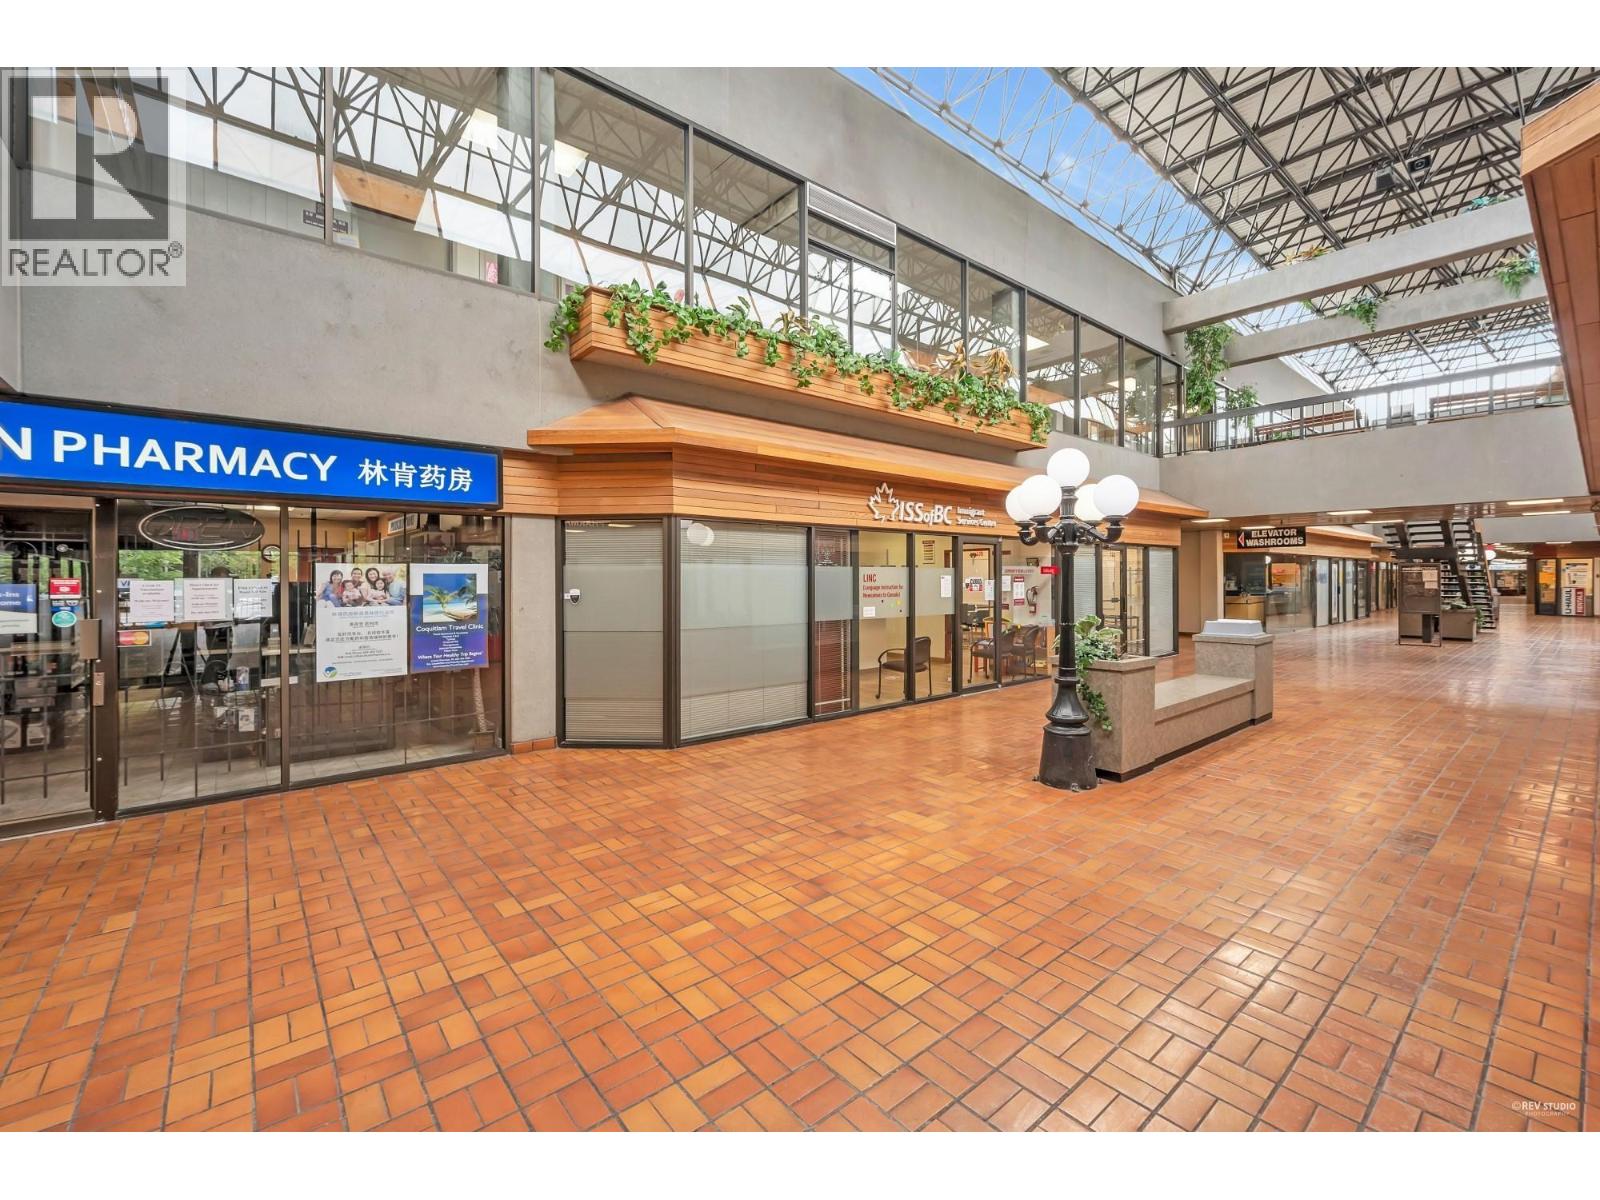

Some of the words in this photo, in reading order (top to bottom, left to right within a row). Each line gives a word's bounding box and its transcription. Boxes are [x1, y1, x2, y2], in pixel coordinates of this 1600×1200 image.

[0, 426, 32, 461] N
[54, 429, 338, 481] PHARMACY
[357, 457, 474, 493] 林肯药房
[1251, 528, 1297, 538] ELEVATOR
[1246, 536, 1304, 547] WASHROOMS
[863, 573, 877, 583] LINC
[1564, 588, 1572, 614] U-HAUL
[415, 625, 447, 633] Coquitlam
